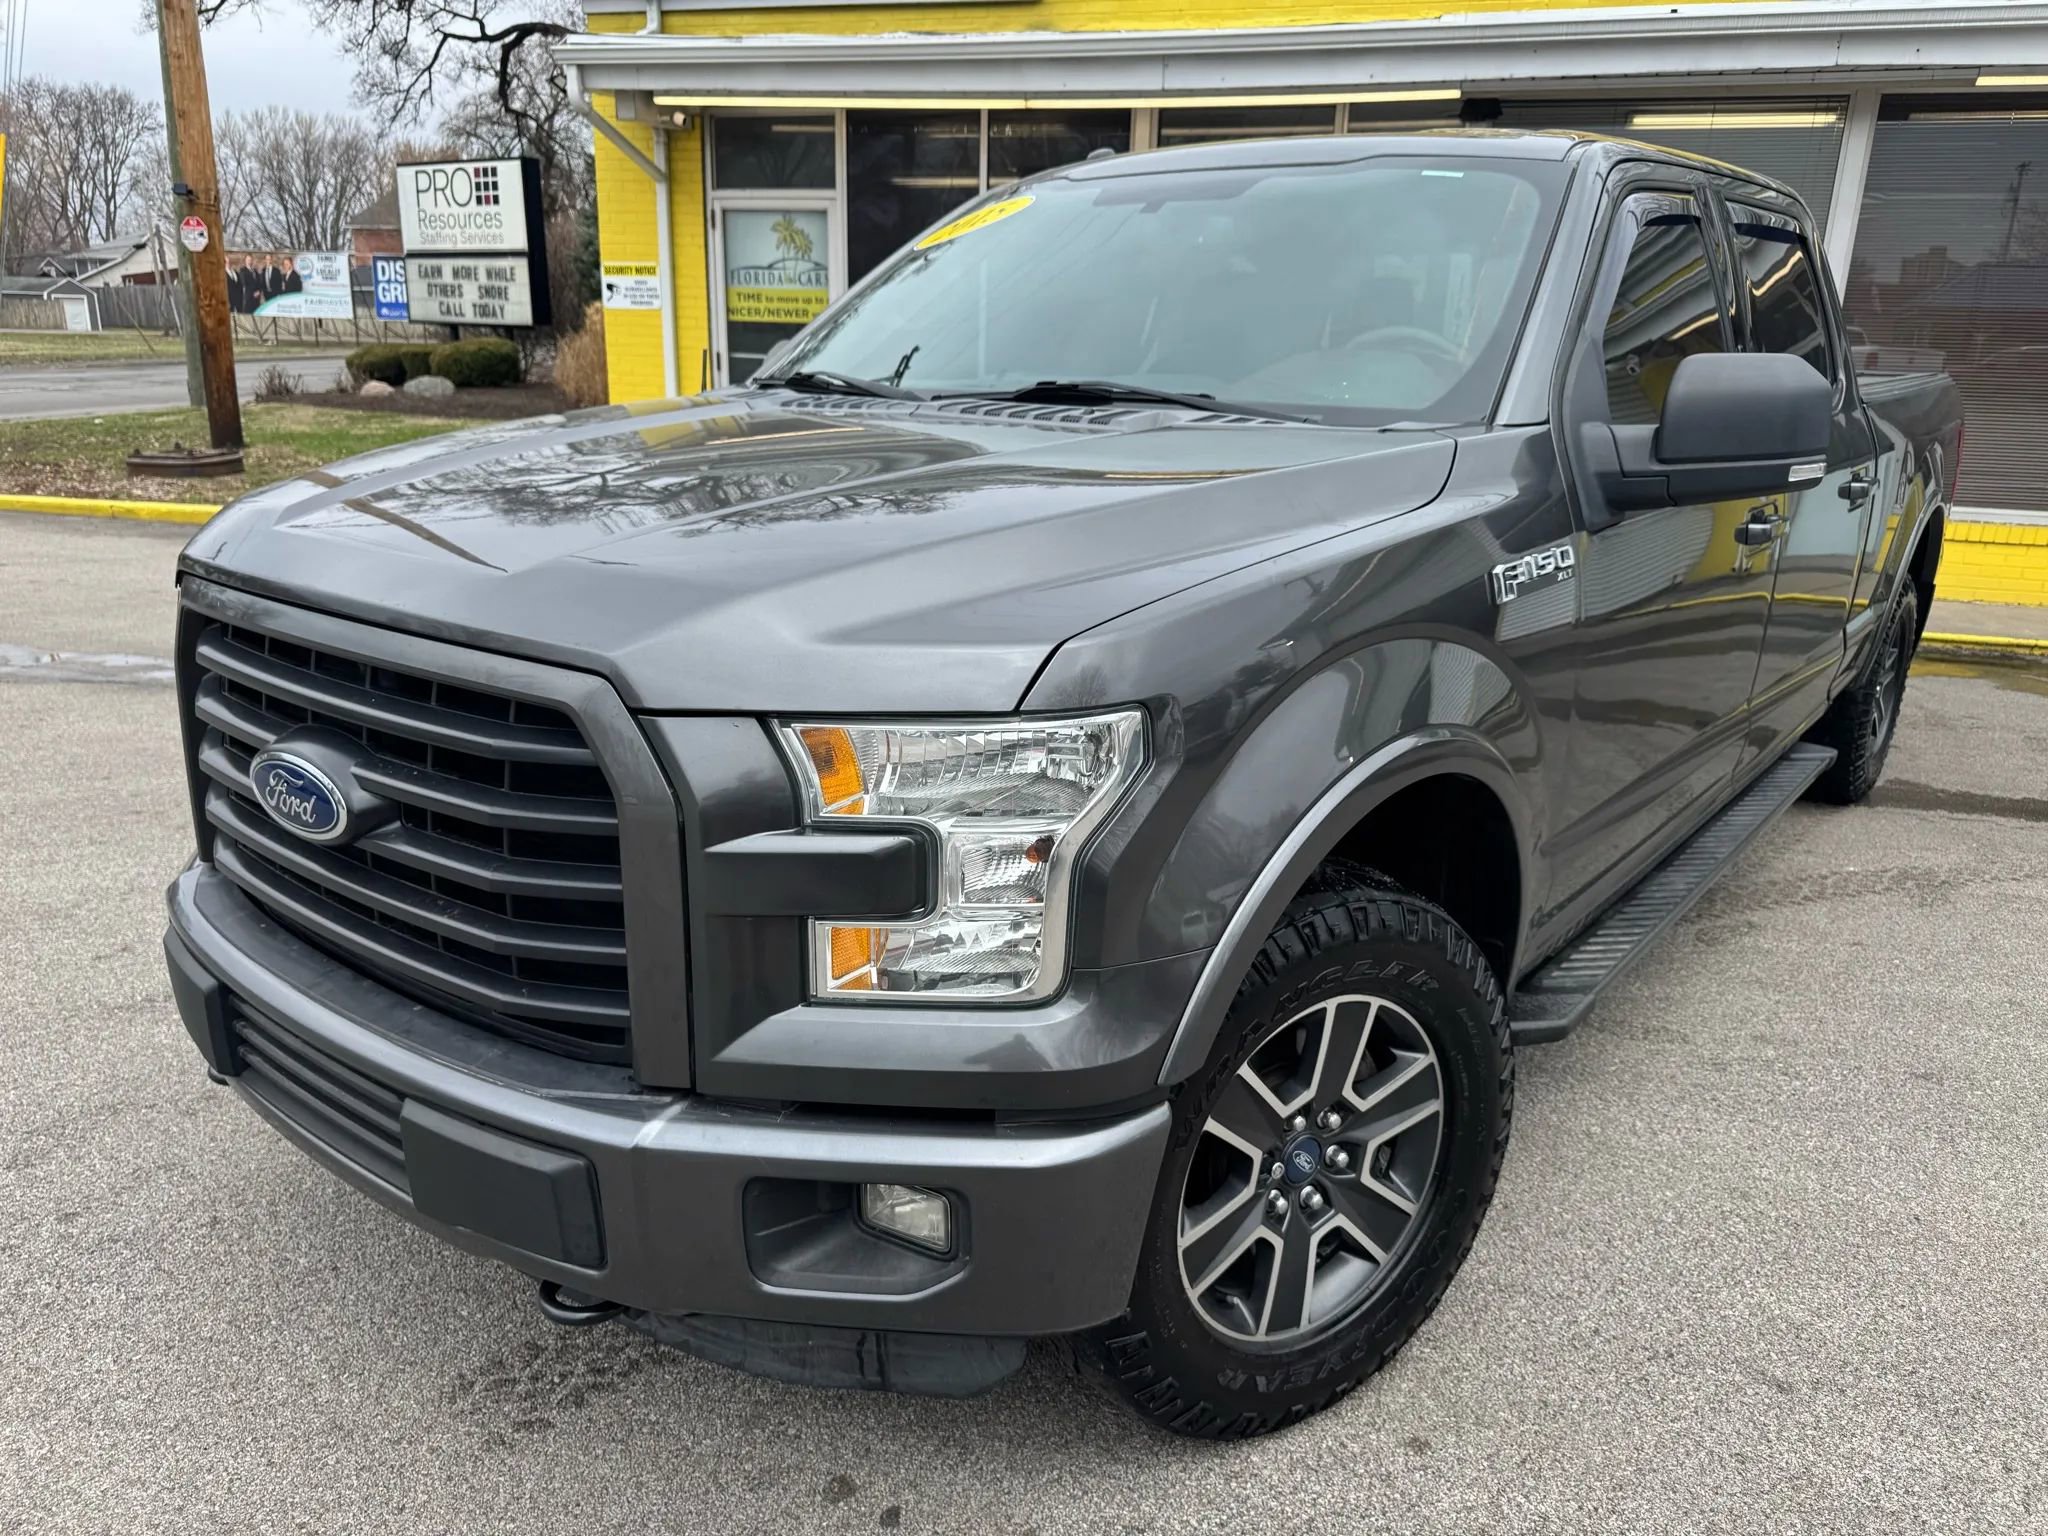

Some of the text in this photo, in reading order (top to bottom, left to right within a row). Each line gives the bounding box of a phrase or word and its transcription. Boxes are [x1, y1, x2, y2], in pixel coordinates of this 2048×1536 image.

[415, 167, 473, 208] PRO
[418, 208, 503, 230] Resources
[420, 230, 504, 248] Staffing Services
[376, 260, 405, 282] DIS
[418, 263, 516, 282] EARN MORE WHILE
[604, 265, 656, 276] SECURITY NOTICE
[730, 270, 784, 287] FLORIDA
[427, 283, 510, 301] OTHERS SNORE
[736, 291, 763, 303] TIME
[765, 294, 775, 303] to
[801, 297, 813, 305] up
[439, 301, 505, 320] CALL TODAY
[727, 306, 810, 319] NICER/NEWER
[1557, 567, 1574, 581] XLT
[265, 768, 317, 824] Ford
